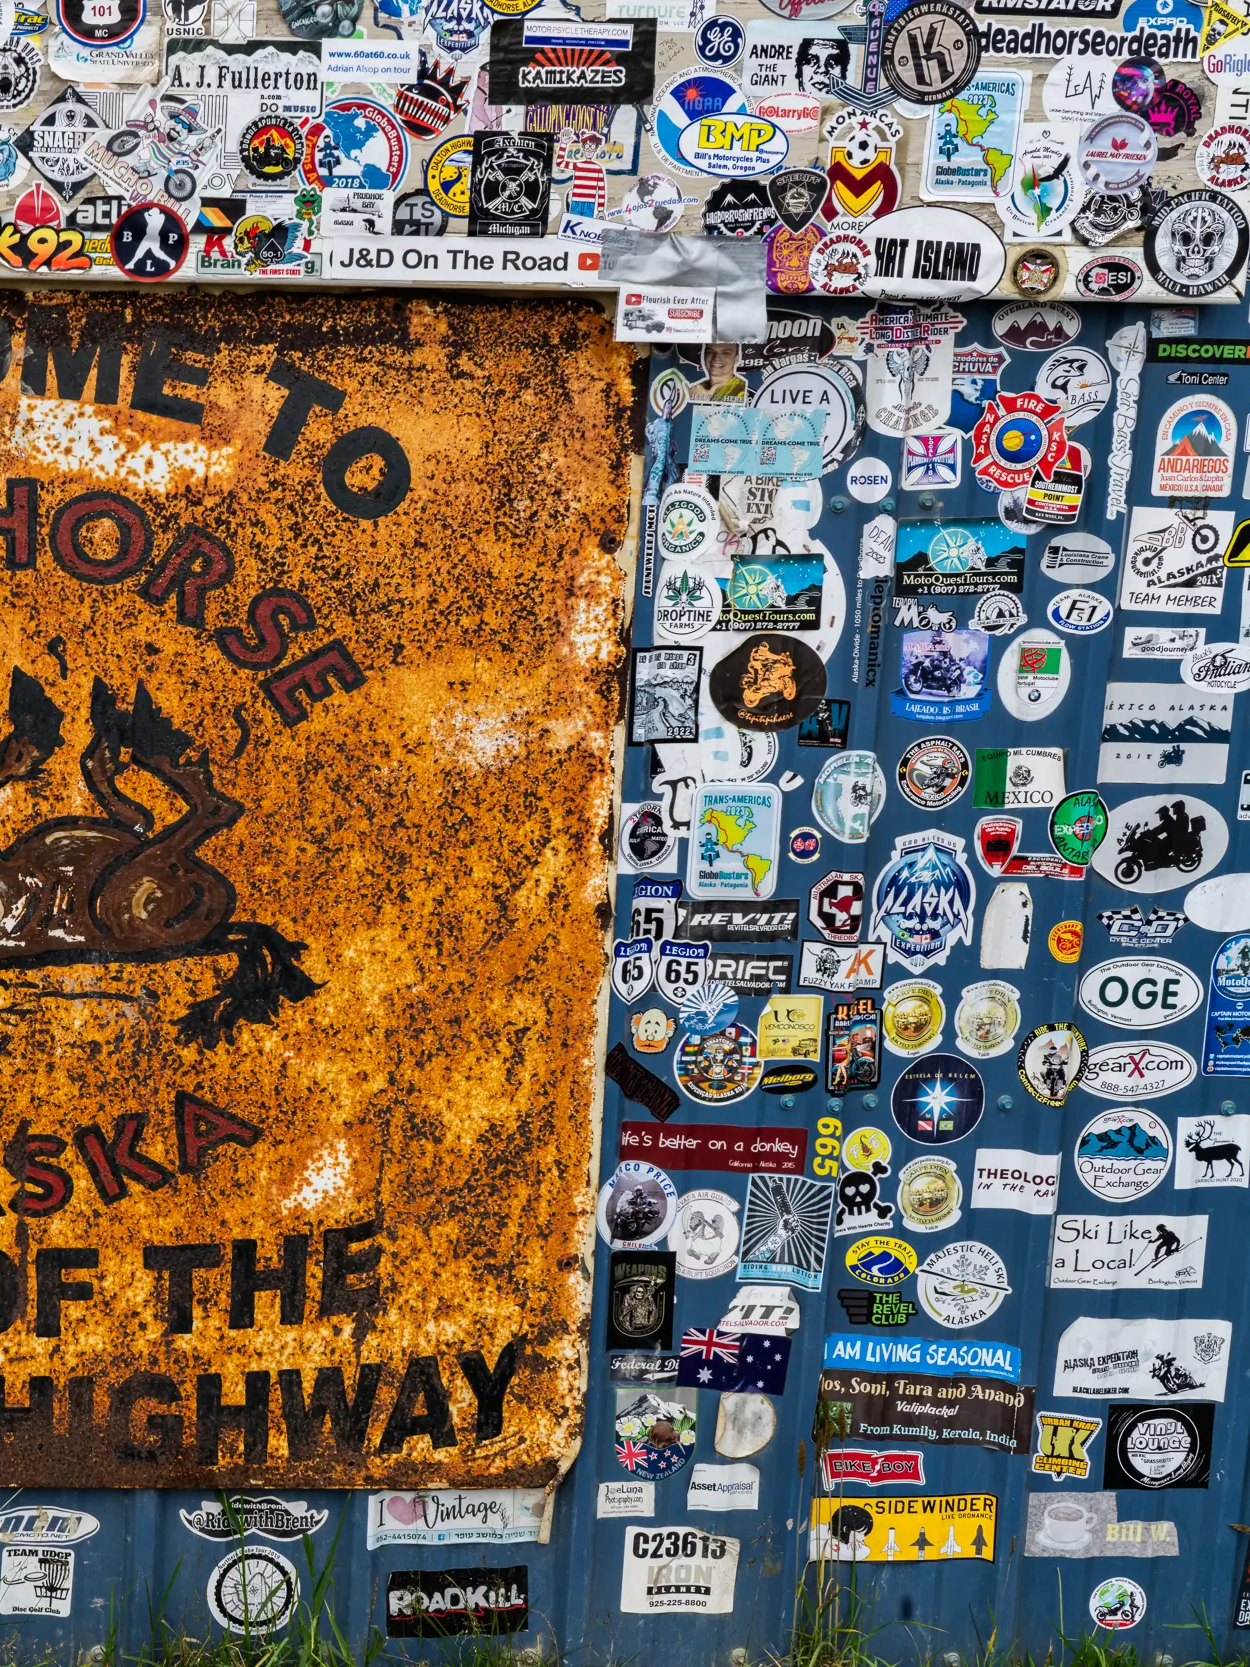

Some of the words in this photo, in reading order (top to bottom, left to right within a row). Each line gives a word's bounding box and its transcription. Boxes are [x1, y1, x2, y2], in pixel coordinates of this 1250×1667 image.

[166, 27, 204, 36] USNIC
[526, 25, 629, 37] MOTORPSYCLETHERAPY.COM
[977, 23, 1198, 59] deadhorseordeath
[328, 50, 411, 60] www.60at60.co.uk
[751, 45, 792, 59] ANDRE
[327, 64, 352, 73] Adrian
[355, 65, 377, 74] Alsop
[759, 64, 777, 73] THE
[217, 65, 318, 91] Fullerton
[520, 68, 625, 87] KAMIKAZES
[751, 73, 787, 87] GIANT
[352, 192, 384, 200] PRUDHOE
[488, 224, 530, 234] Michigan
[25, 227, 94, 270] 92
[339, 247, 395, 269] J&D
[401, 249, 439, 269] On
[446, 249, 494, 270] The
[502, 250, 569, 271] Road
[874, 237, 909, 278] HAT
[915, 238, 981, 282] ISLAND
[643, 295, 670, 305] Flourish
[673, 297, 688, 305] Ever
[691, 298, 708, 306] After
[1181, 373, 1199, 383] Toni
[1202, 374, 1228, 385] Center
[1016, 399, 1044, 413] FIRE
[262, 357, 411, 519] TO
[1158, 458, 1228, 474] ANDARIEGOS
[851, 475, 888, 486] ROSEN
[988, 466, 1030, 482] RESCUE
[1034, 481, 1079, 493] SOUTHERNMOST
[1042, 492, 1064, 502] POINT
[903, 573, 1017, 586] MotoQuestTours.com
[1129, 592, 1162, 605] TEAM
[1166, 595, 1216, 608] MEMBER
[658, 610, 712, 622] DROPTINE
[703, 795, 771, 808] TRANS-AMERICAS
[984, 791, 1052, 804] MEXICO
[689, 912, 797, 926] REV'IT!
[727, 924, 791, 932] REVITELSALVADOR.COM
[1099, 975, 1180, 1010] OGE
[1100, 1080, 1165, 1094] 888-547-4327
[658, 1133, 701, 1149] better
[708, 1140, 727, 1150] on
[734, 1142, 744, 1152] a
[750, 1137, 798, 1158] donkey
[1080, 1162, 1131, 1176] Outdoor
[1134, 1165, 1163, 1176] Gear
[1094, 1176, 1149, 1189] Exchange
[1057, 1220, 1100, 1243] Ski
[1107, 1220, 1152, 1244] Like
[1055, 1258, 1065, 1269] a
[1074, 1250, 1133, 1272] Local
[143, 1218, 382, 1334] THE
[874, 1293, 899, 1302] THE
[873, 1304, 916, 1314] REVEL
[872, 1314, 906, 1325] CLUB
[833, 1344, 862, 1358] AM
[866, 1343, 921, 1363] LIVING
[926, 1345, 1012, 1370] SEASONAL
[896, 1400, 959, 1418] Valiplackal
[859, 1423, 893, 1435] From
[892, 1424, 940, 1440] Kumily,
[942, 1428, 983, 1441] Kerala,
[985, 1430, 1018, 1448] India
[1138, 1422, 1183, 1437] VINYL
[1128, 1437, 1190, 1451] LOUNGE
[832, 1460, 872, 1472] BIKE
[882, 1461, 914, 1473] BOY
[690, 1481, 716, 1491] Asset
[717, 1482, 753, 1492] Appraisal
[420, 1497, 503, 1528] Vintage
[875, 1498, 993, 1515] SIDEWINDER
[376, 1532, 427, 1543] 052-4415074
[1106, 1524, 1142, 1542] Bill
[1152, 1524, 1171, 1541] W.
[633, 1532, 726, 1559] C23613
[649, 1599, 707, 1608] 925-225-8800
